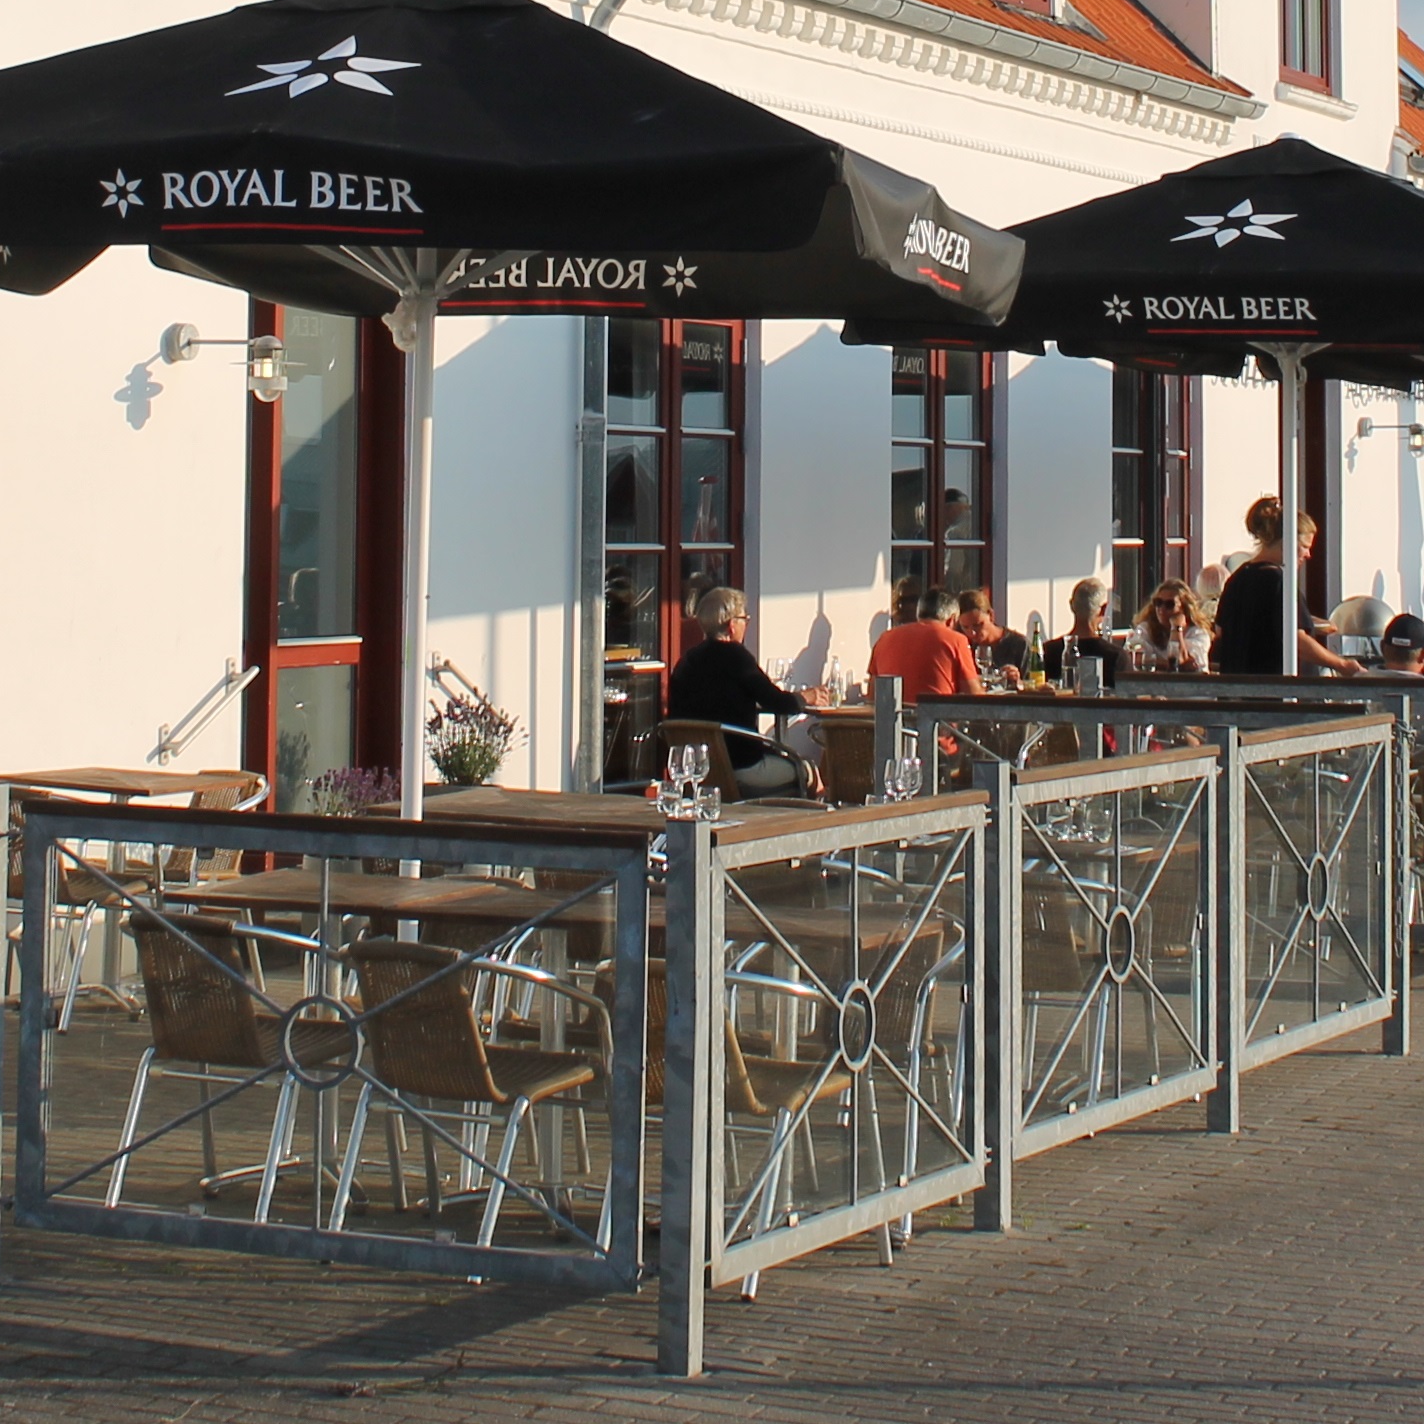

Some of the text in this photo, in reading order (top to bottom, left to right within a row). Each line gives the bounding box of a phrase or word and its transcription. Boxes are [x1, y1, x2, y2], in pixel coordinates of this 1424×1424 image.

[161, 168, 424, 214] ROYAL BEER
[934, 226, 971, 274] BEER
[1142, 296, 1318, 321] ROYAL BEER
